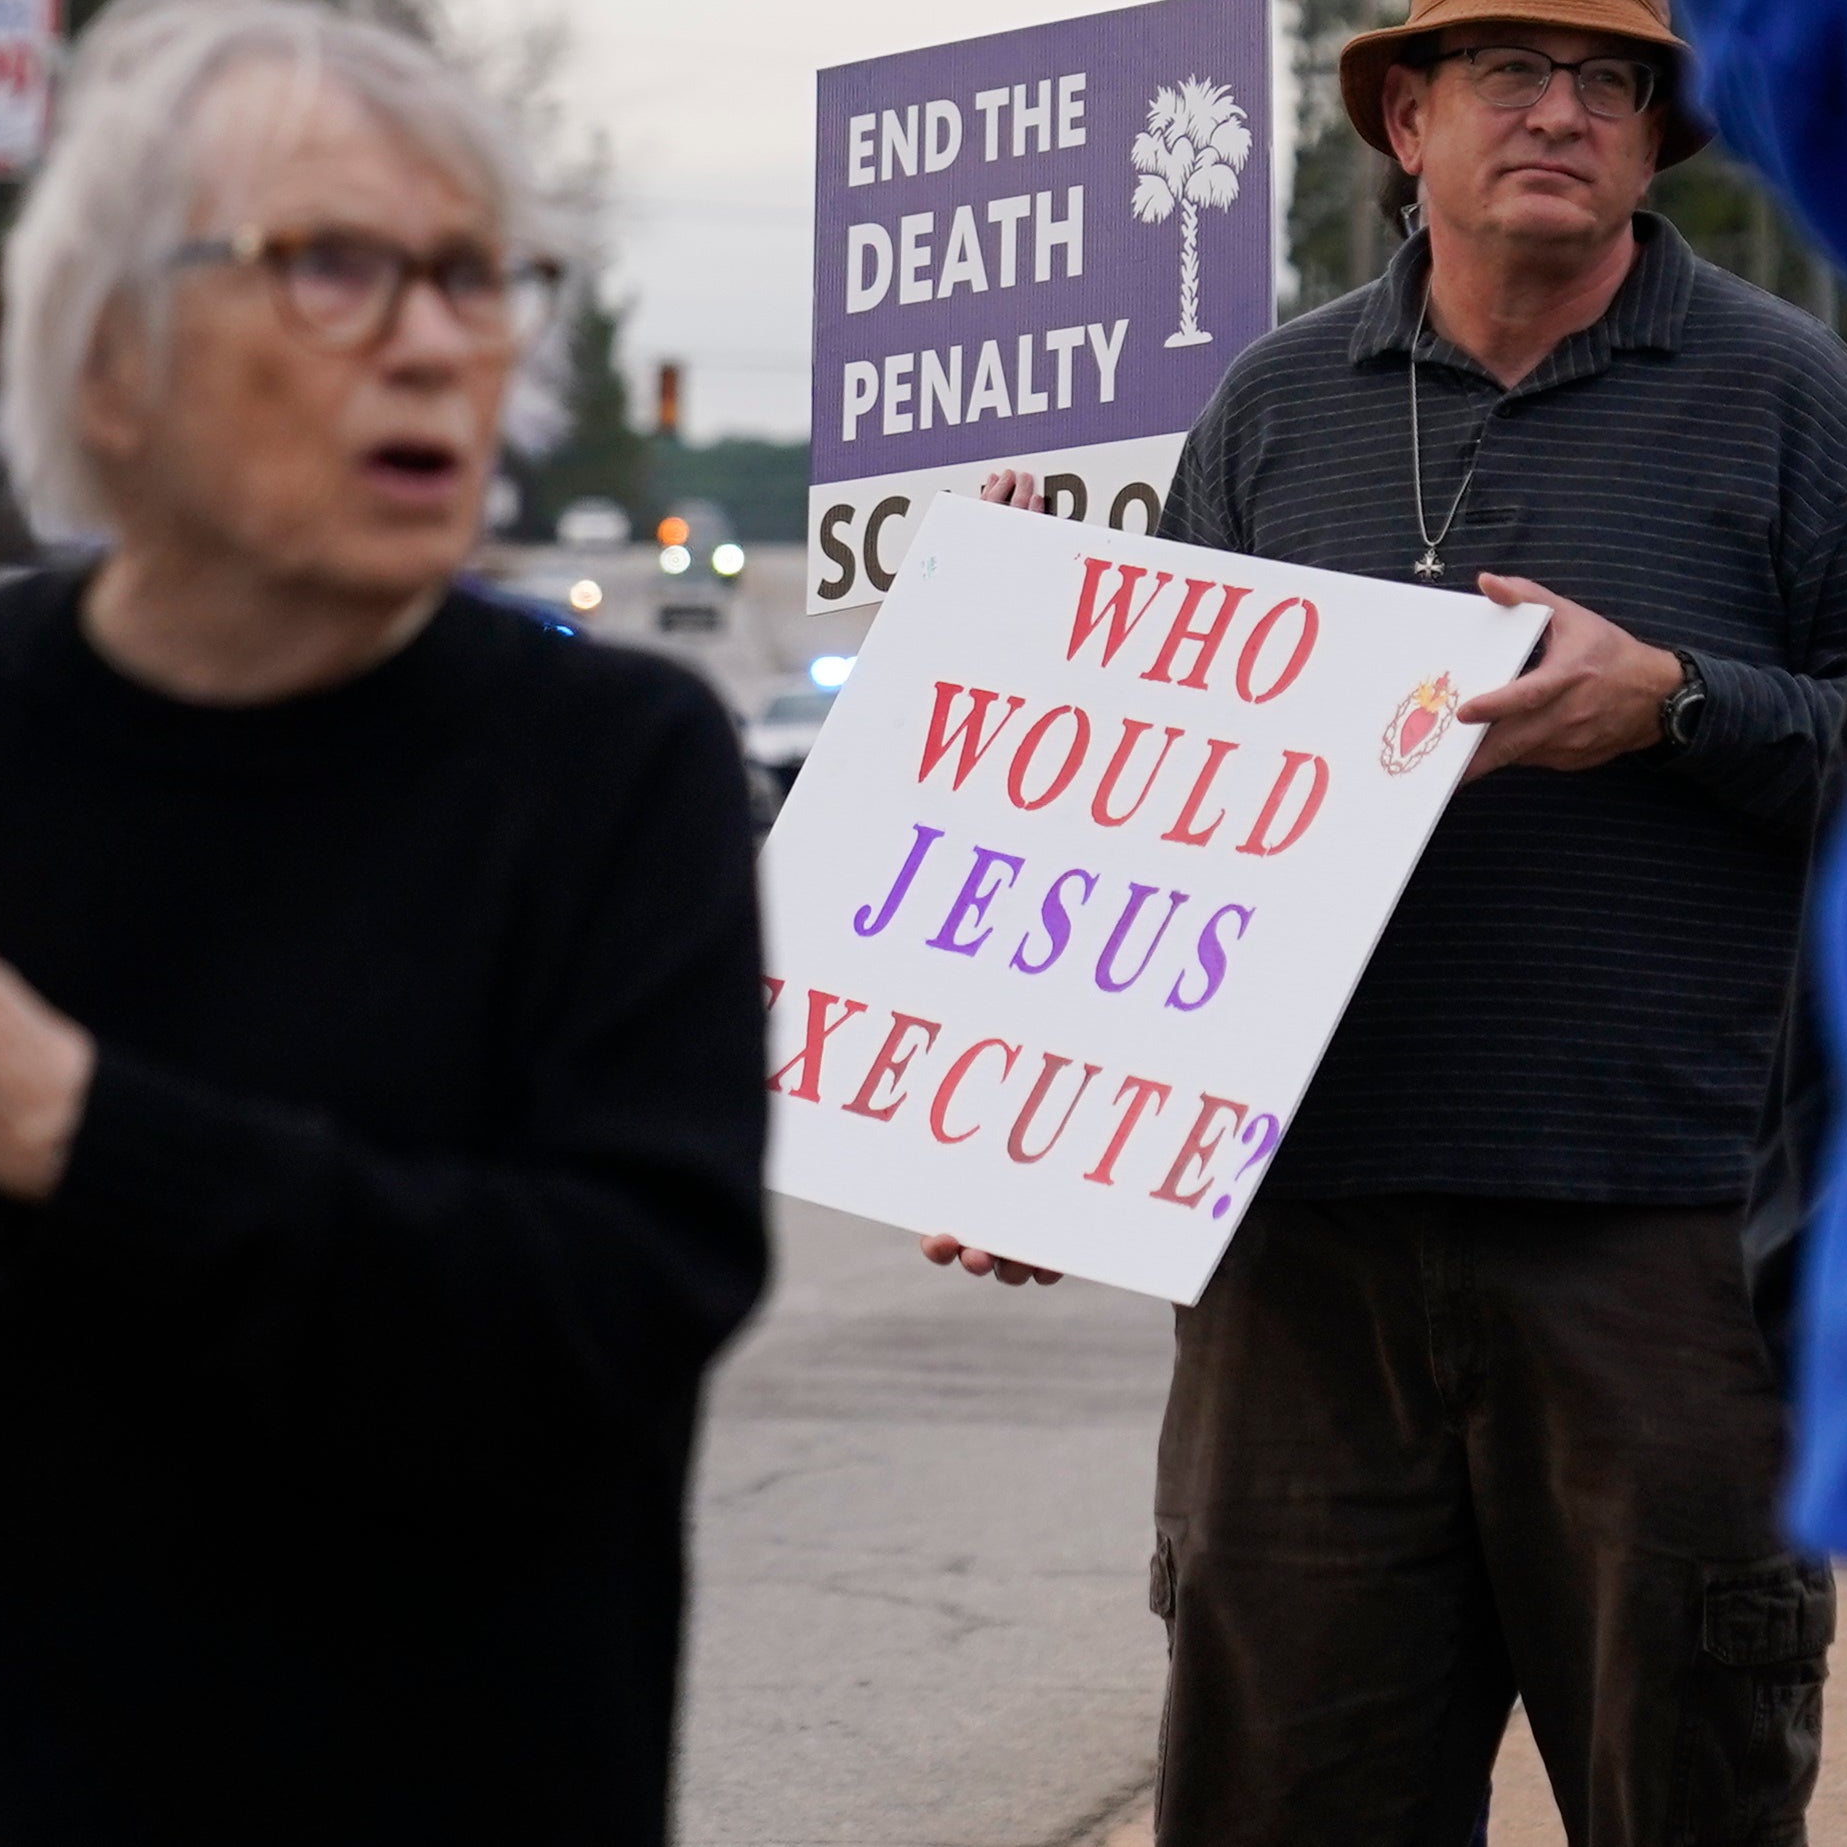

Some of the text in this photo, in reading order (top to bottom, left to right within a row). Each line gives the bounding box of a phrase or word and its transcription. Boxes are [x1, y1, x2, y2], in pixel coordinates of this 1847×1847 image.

[849, 74, 1087, 186] END THE
[846, 186, 1084, 314] DEATH
[842, 320, 1129, 441] PENALTY
[1065, 556, 1320, 704] WHO
[917, 682, 1329, 857] WOULD
[853, 823, 1257, 1012] JESUS
